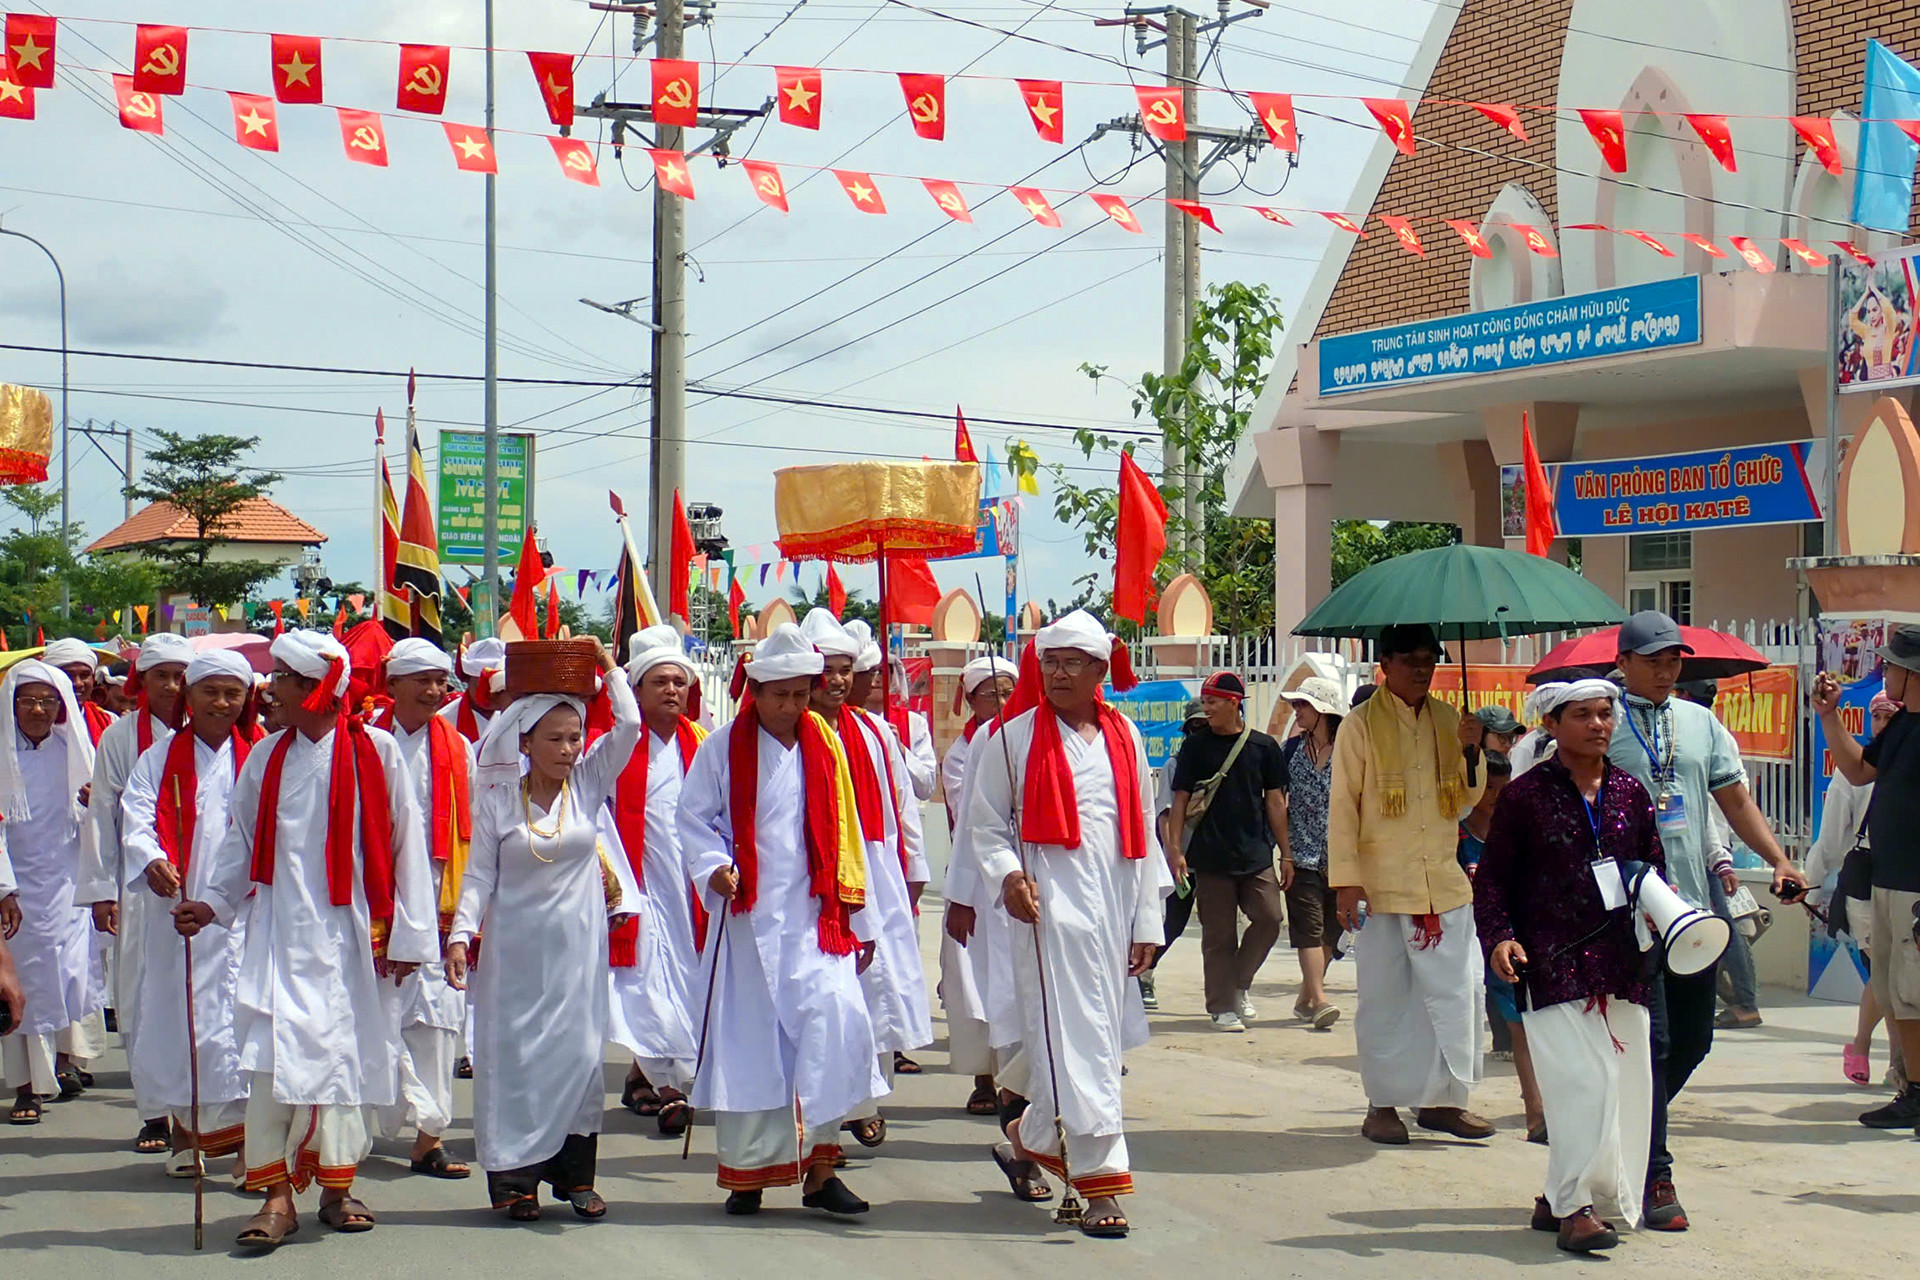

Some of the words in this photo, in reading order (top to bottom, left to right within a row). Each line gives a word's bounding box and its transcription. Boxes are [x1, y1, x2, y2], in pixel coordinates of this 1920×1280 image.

[1371, 335, 1402, 353] TRUNG
[1405, 330, 1426, 348] TÂM
[1428, 328, 1450, 344] SINH
[1574, 470, 1607, 500] VĂN
[1610, 466, 1665, 498] PHÒNG
[1670, 466, 1705, 492] BAN
[1709, 454, 1731, 488] TỔ
[1735, 454, 1783, 487] CHỨC
[1603, 503, 1633, 527] LỄ
[1638, 503, 1679, 526] HỘI
[1684, 496, 1750, 520] KATÊ
[1722, 684, 1774, 734] NĂM
[1780, 693, 1788, 735] !
[1837, 701, 1865, 736] ÓN
